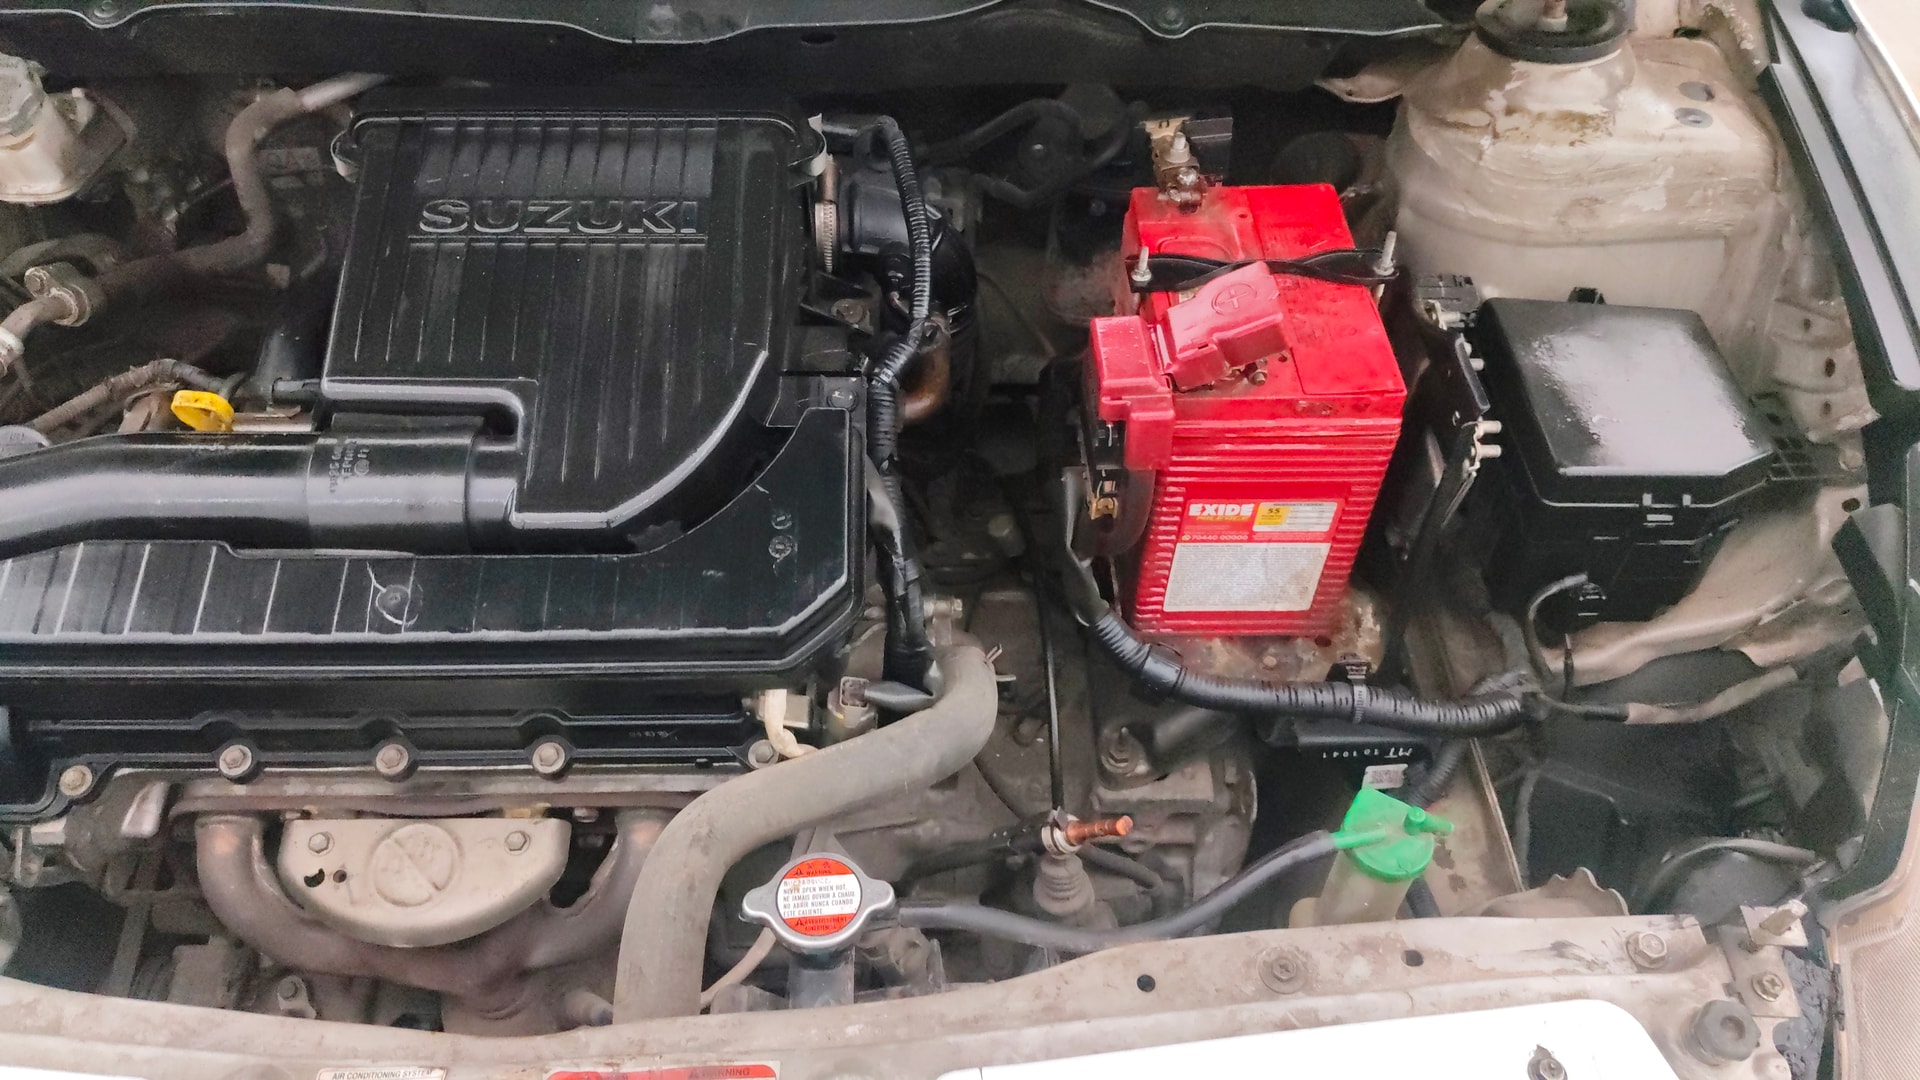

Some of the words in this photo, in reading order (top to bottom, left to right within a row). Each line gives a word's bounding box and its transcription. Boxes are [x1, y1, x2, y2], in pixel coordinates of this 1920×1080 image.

[419, 199, 697, 234] SUZUKI
[1188, 503, 1255, 516] EXIDE
[1383, 747, 1413, 758] MT
[792, 894, 810, 902] JAMAIS
[831, 898, 853, 906] CUANDO
[332, 1072, 346, 1080] AIR
[346, 1070, 401, 1080] CONDITIONING
